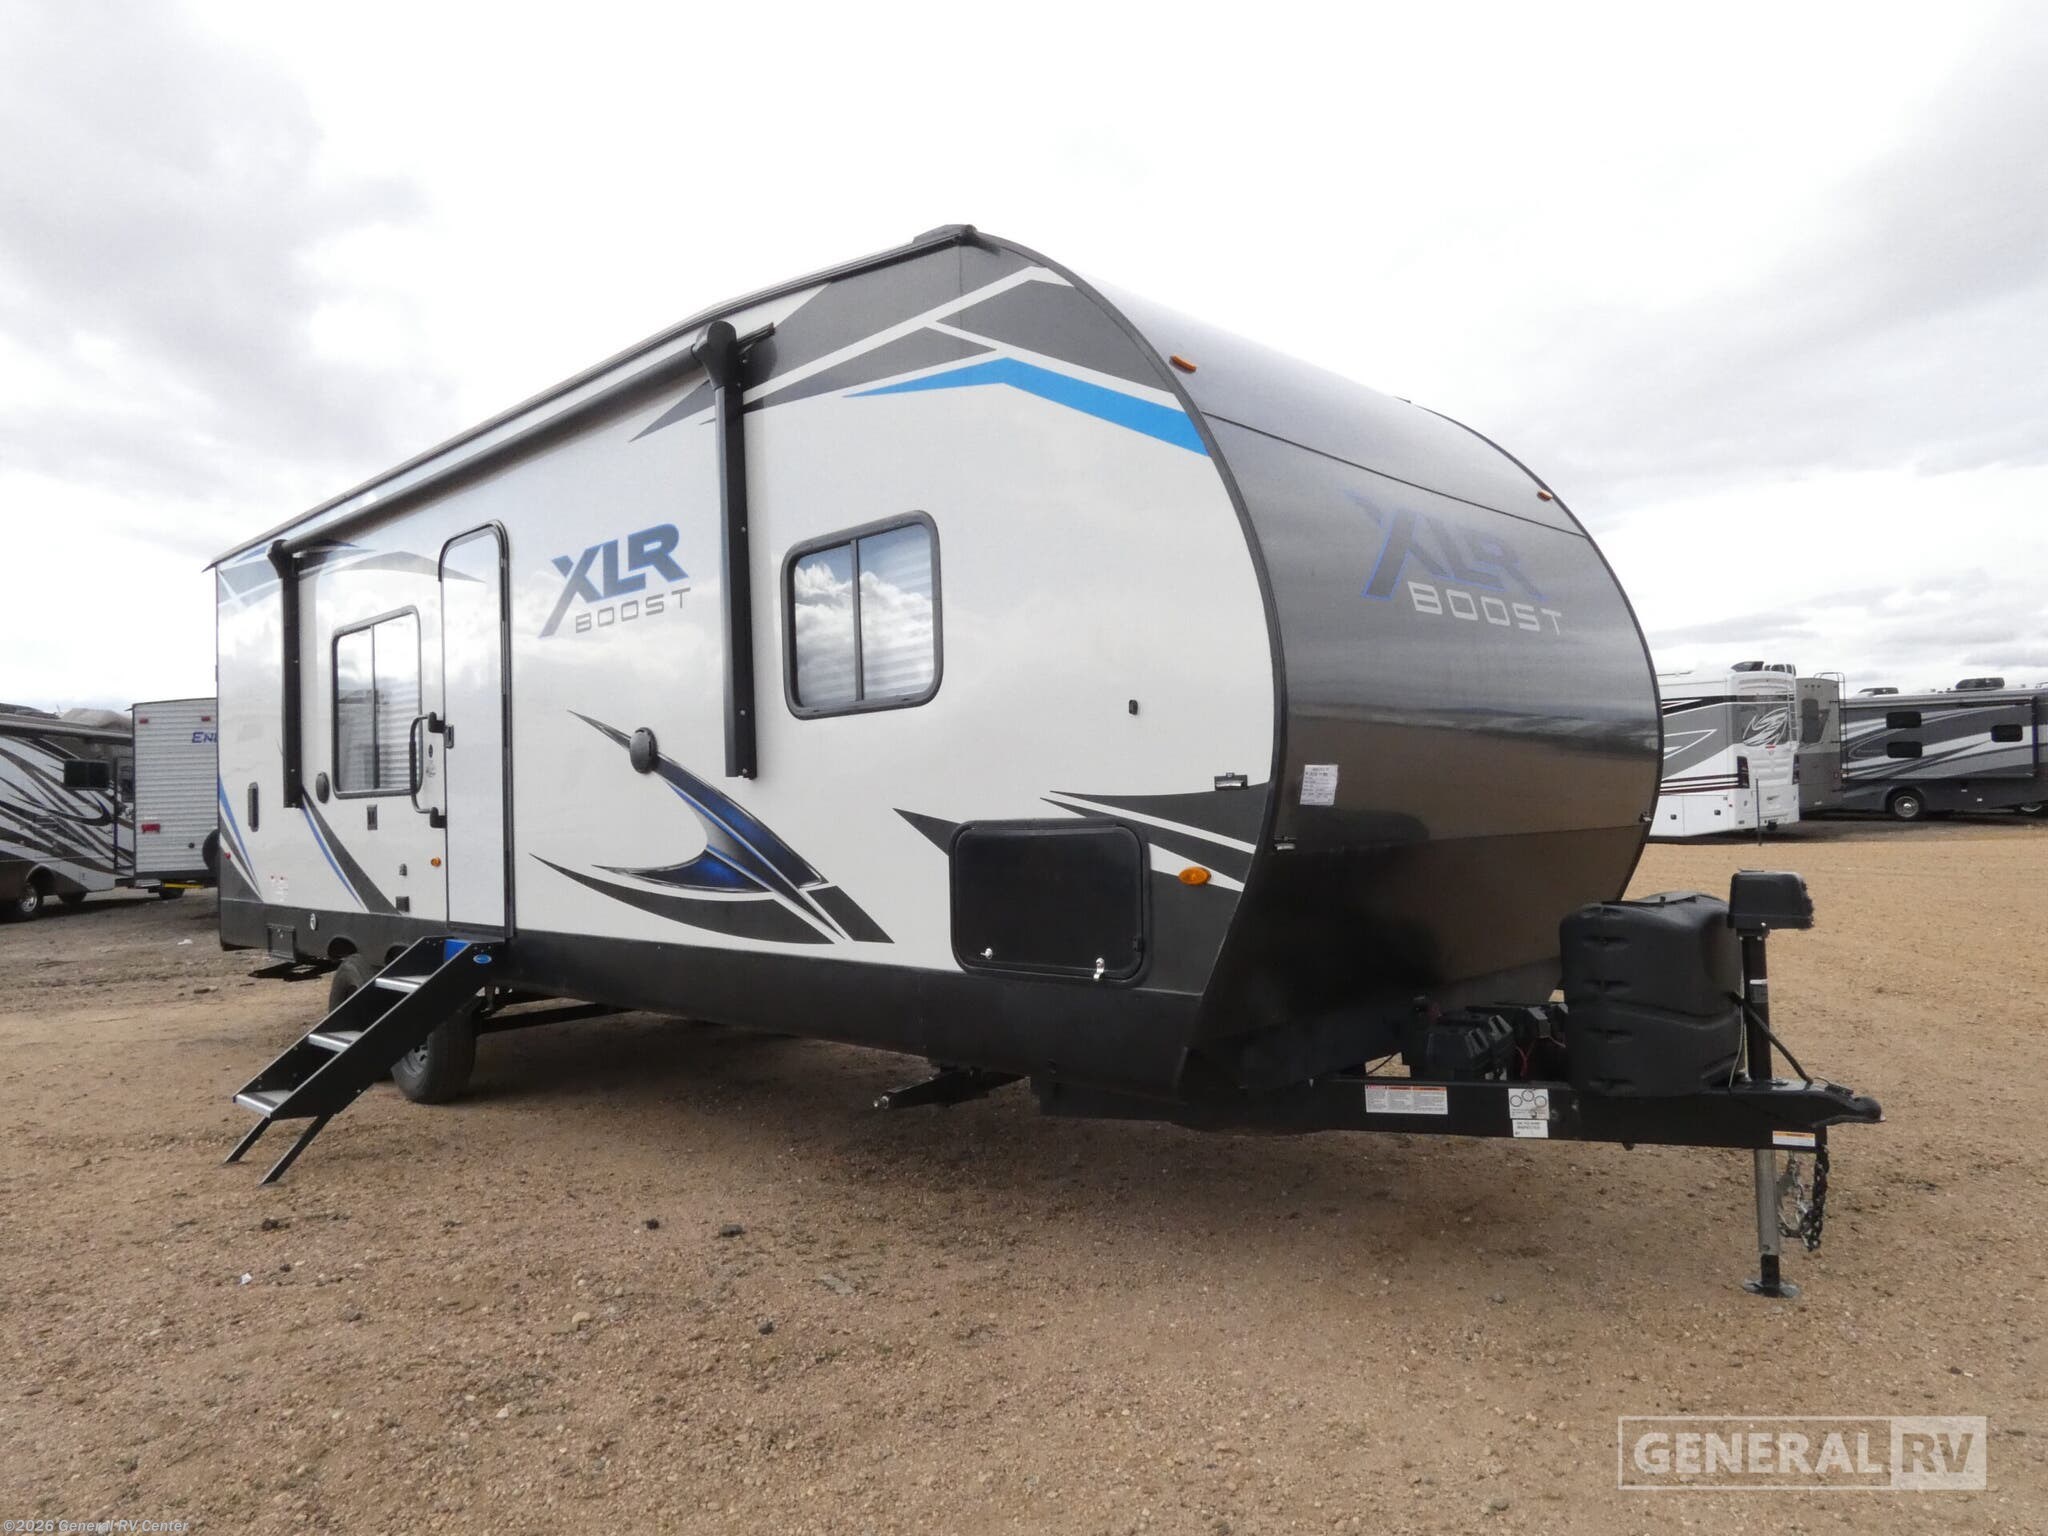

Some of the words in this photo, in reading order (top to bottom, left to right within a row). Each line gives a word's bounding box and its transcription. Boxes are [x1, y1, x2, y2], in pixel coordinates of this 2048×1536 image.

[538, 523, 689, 639] XLR
[1345, 488, 1548, 600] XLR
[575, 587, 691, 634] BOOST
[1407, 581, 1562, 636] BOOST
